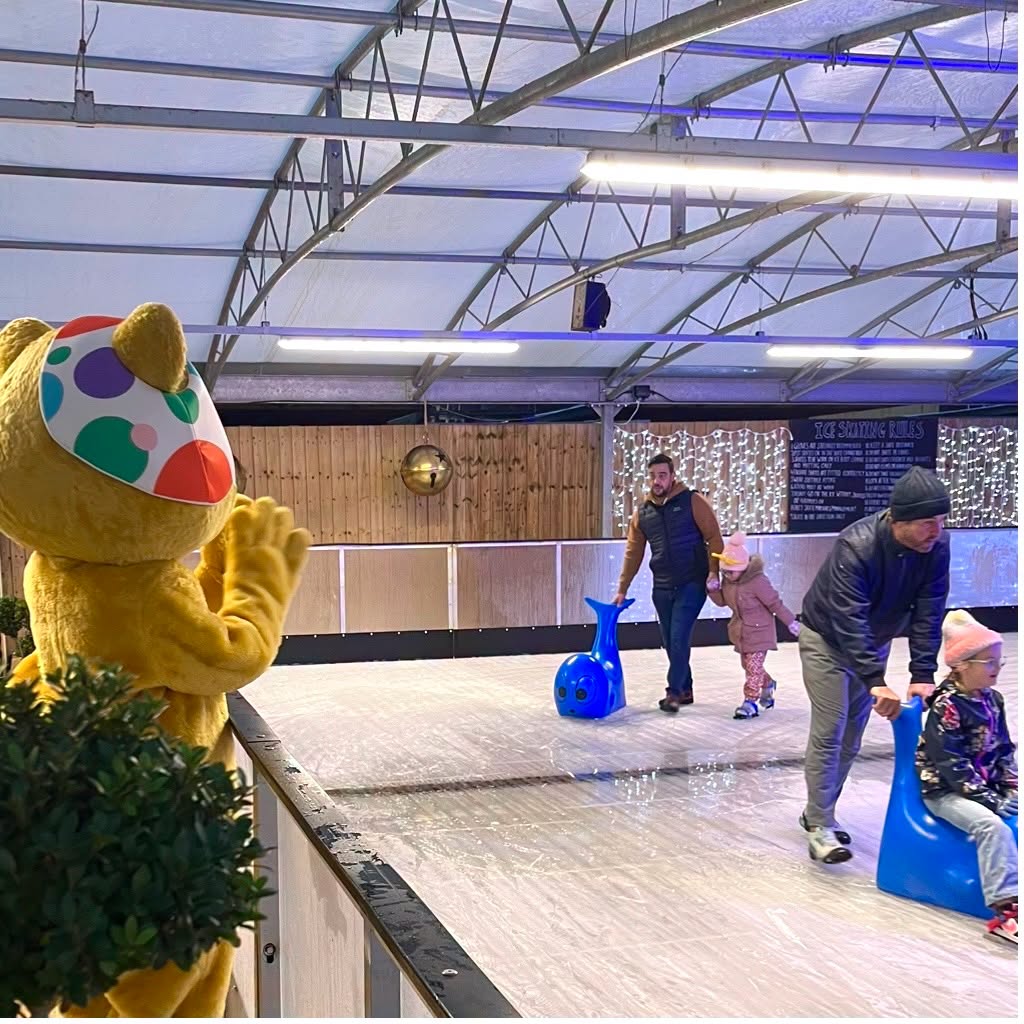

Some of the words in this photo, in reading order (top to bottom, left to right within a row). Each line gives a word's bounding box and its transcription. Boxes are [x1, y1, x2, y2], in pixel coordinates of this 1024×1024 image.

[815, 422, 836, 439] ICE
[838, 421, 886, 439] SKATING
[889, 420, 925, 440] RULES
